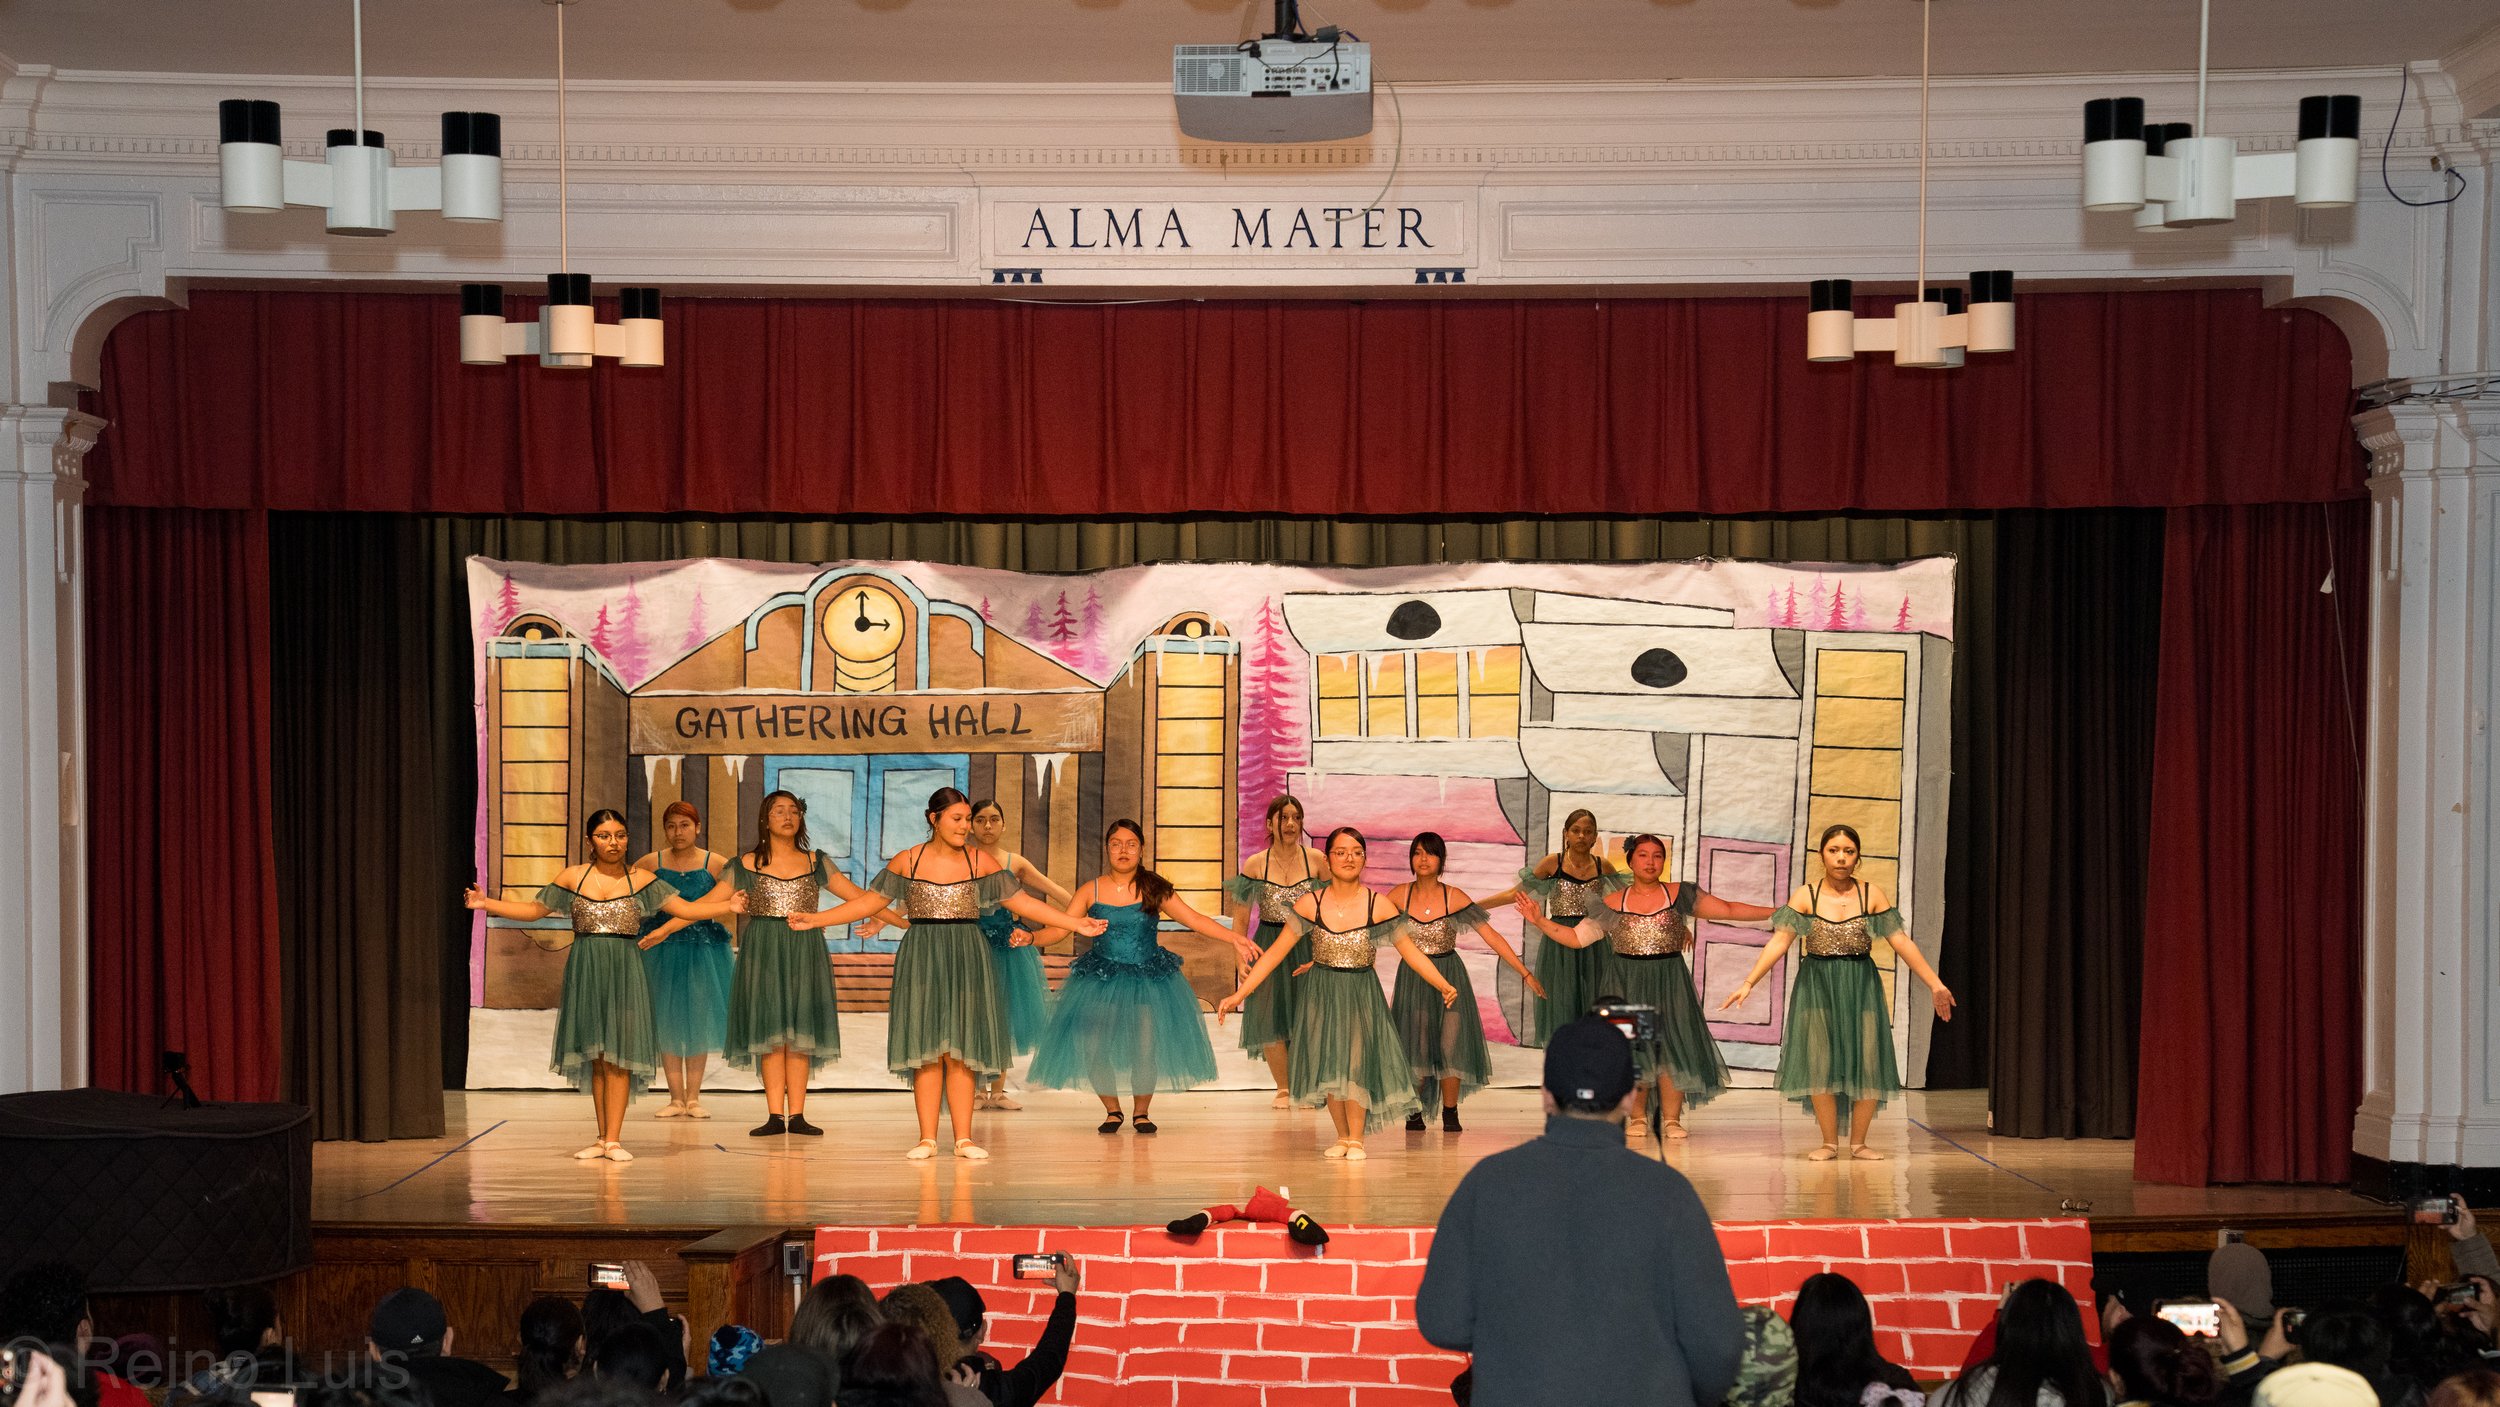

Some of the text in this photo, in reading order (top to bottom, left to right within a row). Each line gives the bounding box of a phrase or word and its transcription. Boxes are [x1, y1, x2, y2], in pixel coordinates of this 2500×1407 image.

[1021, 207, 1435, 249] ALMA MATER
[675, 701, 1032, 741] GATHERING HALL
